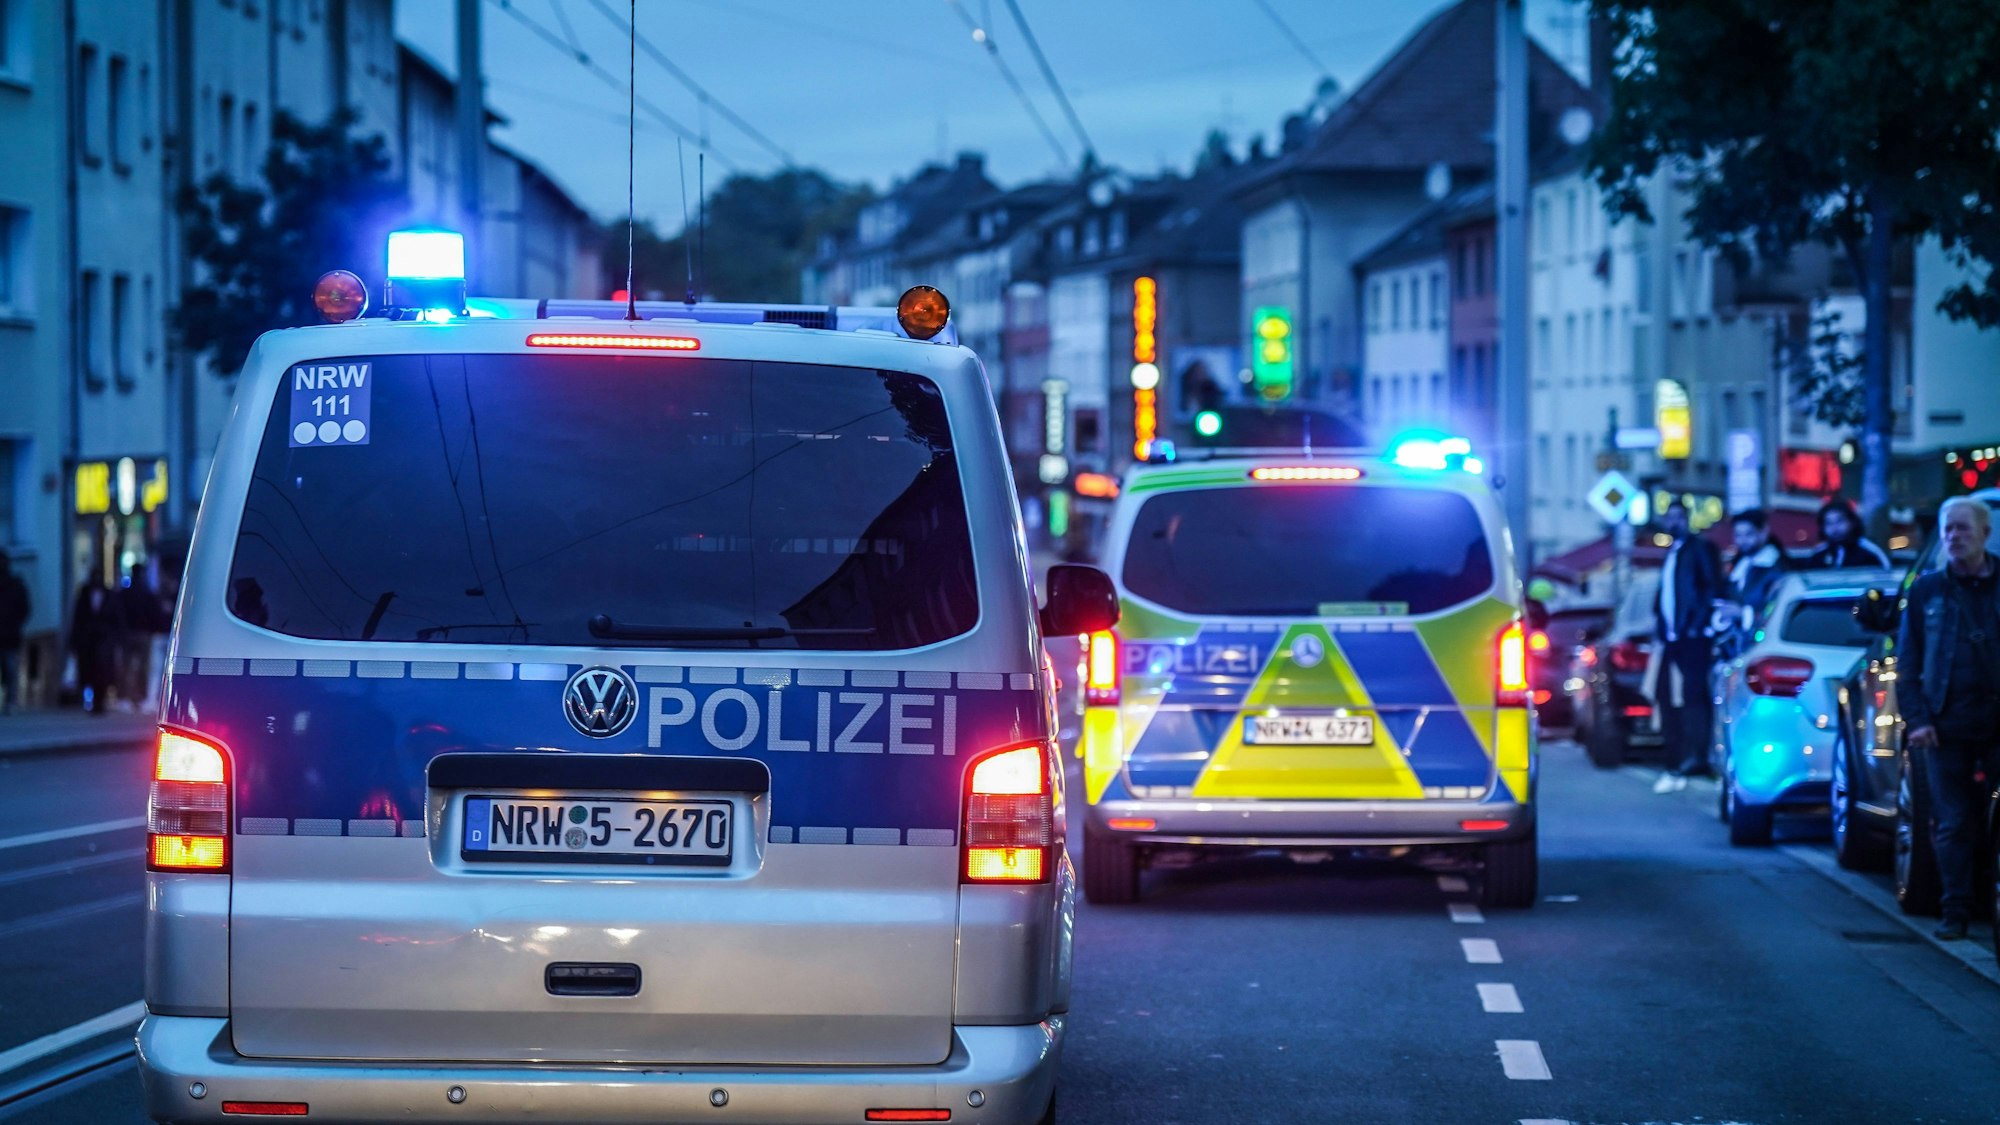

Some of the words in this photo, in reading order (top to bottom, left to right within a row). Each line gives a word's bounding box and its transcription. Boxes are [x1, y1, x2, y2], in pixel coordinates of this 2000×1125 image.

[295, 364, 368, 390] NRW
[311, 394, 350, 416] 111
[1124, 644, 1259, 673] POLIZEI
[647, 687, 957, 755] POLIZEI
[472, 830, 482, 842] D
[491, 803, 565, 846] NRW
[590, 806, 728, 849] 5-2670
